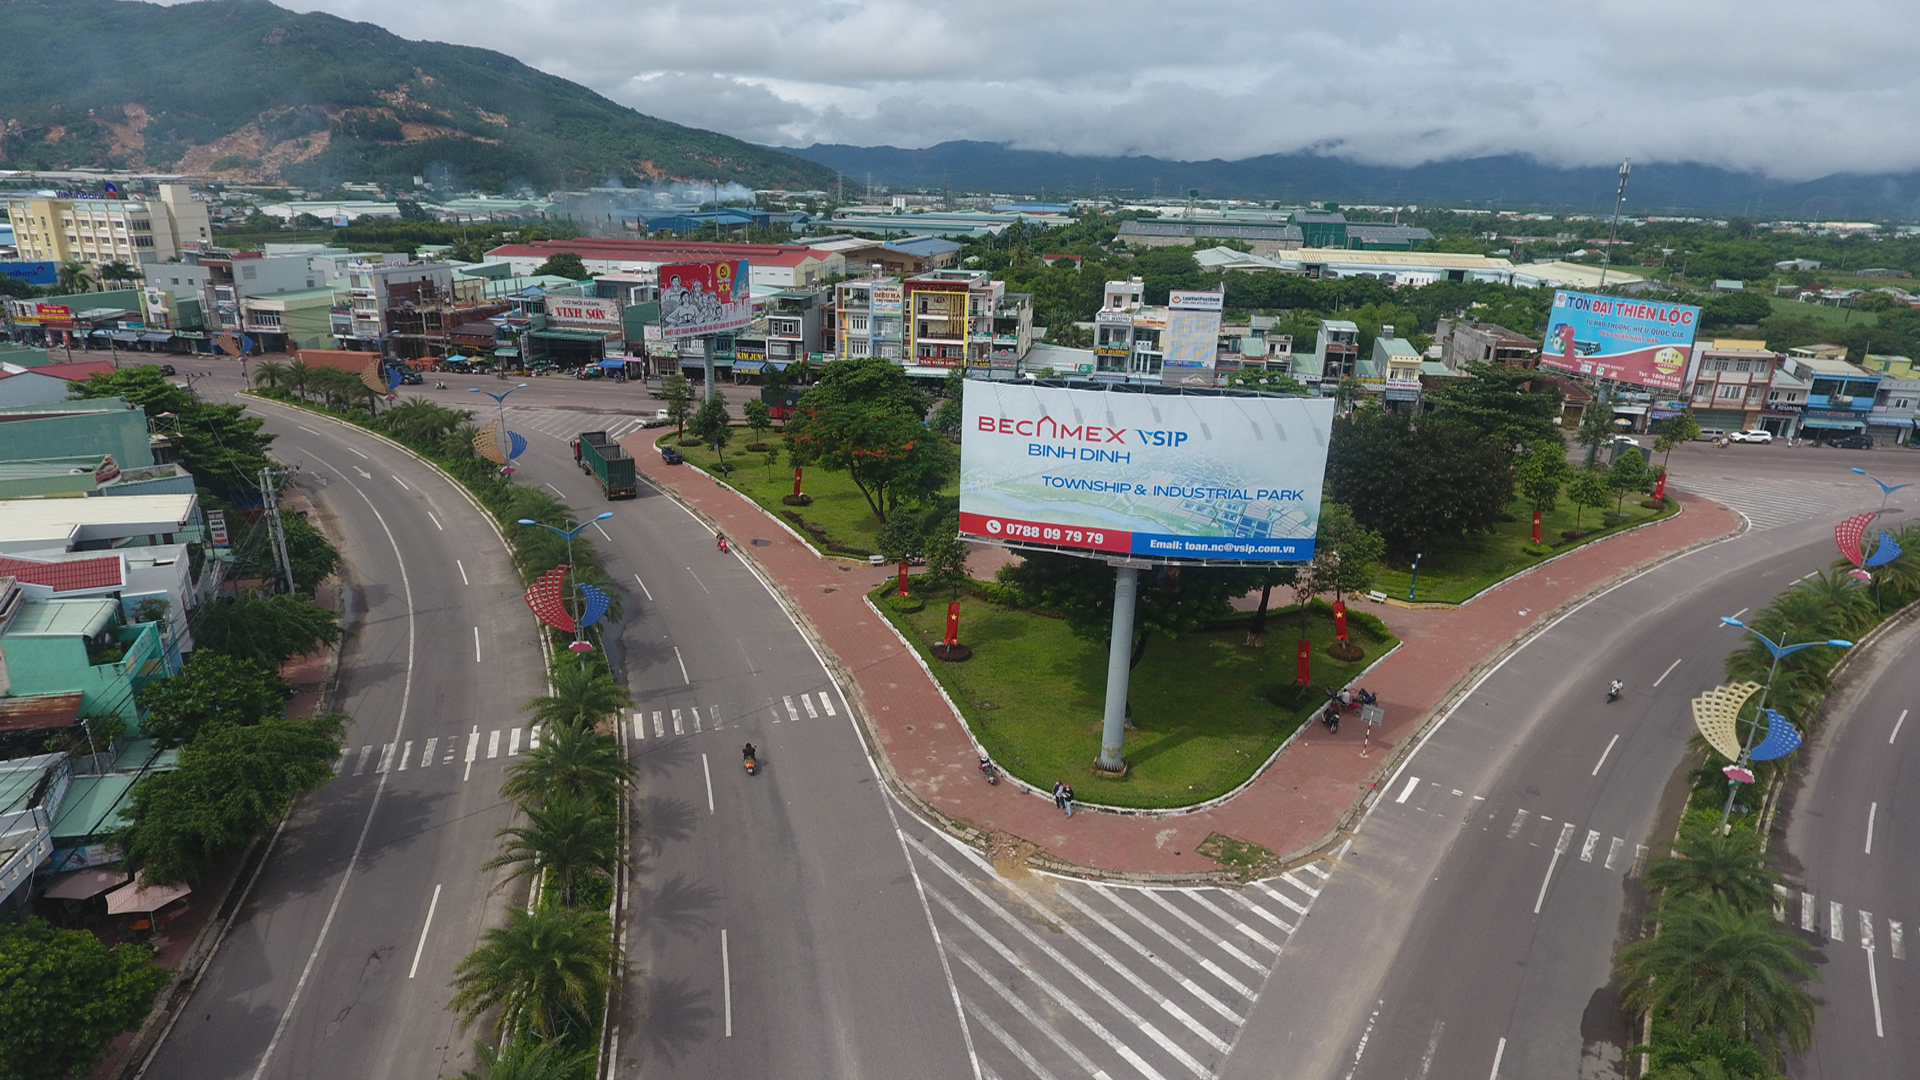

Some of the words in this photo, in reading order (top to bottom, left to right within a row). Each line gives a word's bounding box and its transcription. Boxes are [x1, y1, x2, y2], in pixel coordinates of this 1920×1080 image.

[1568, 295, 1592, 311] TÔN
[1592, 300, 1613, 317] ĐẠI
[1615, 301, 1656, 320] THIÊN
[1658, 306, 1694, 327] LỘC
[978, 415, 1127, 445] BECAMEX
[1133, 428, 1188, 448] VSIP
[1028, 443, 1076, 460] BINH
[1080, 447, 1131, 464] DINH
[1042, 475, 1132, 494] TOWNSHIP
[1134, 483, 1147, 496] &
[1153, 485, 1254, 501] INDUSTRIAL
[1256, 488, 1305, 501] PARK
[1006, 523, 1040, 538] 0788
[1043, 527, 1061, 540] 09
[1064, 530, 1083, 543] 79
[1086, 532, 1104, 545] 79
[1149, 539, 1183, 550] Email:
[1184, 541, 1296, 554] toan.nc@vsip.com.vn
